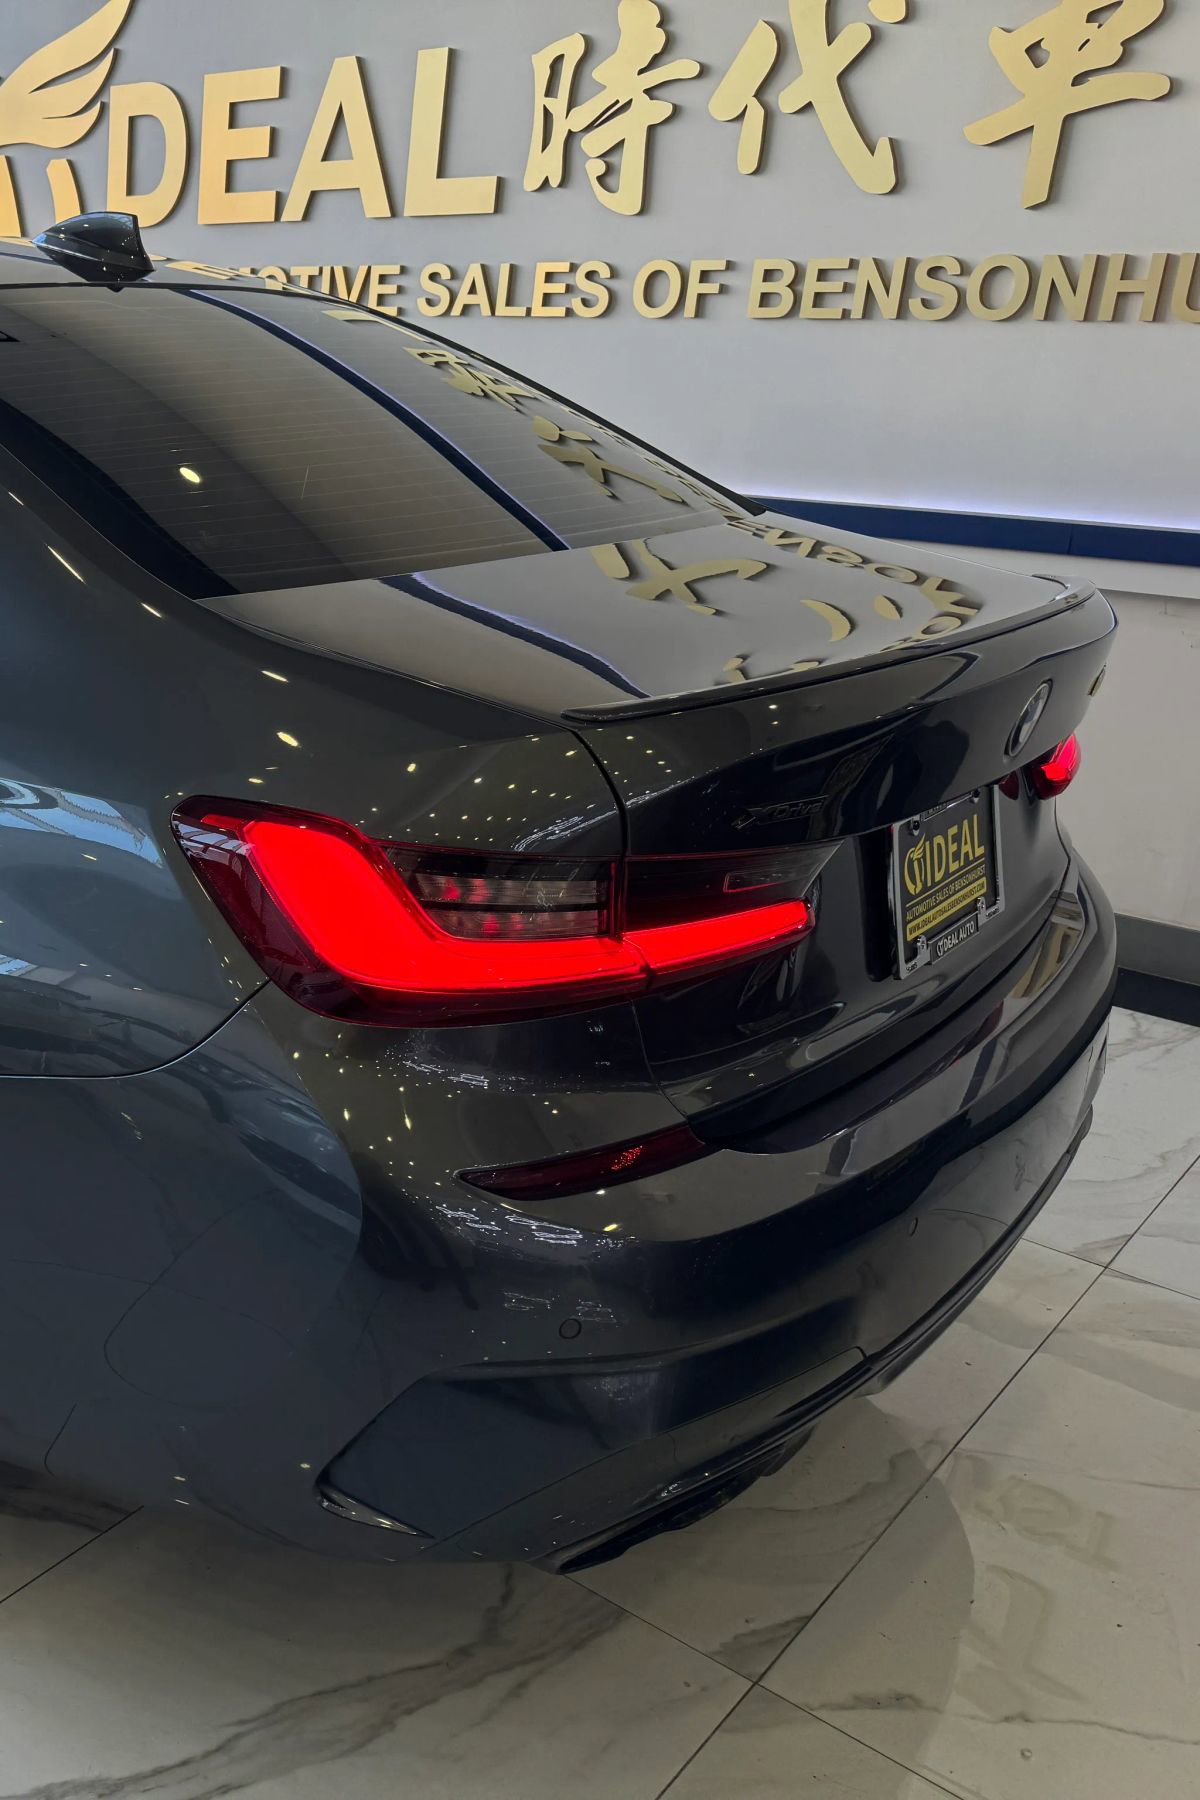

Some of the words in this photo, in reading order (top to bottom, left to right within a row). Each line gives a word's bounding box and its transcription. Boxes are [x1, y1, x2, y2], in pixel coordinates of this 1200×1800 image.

[240, 264, 401, 317] TIVE
[416, 260, 612, 318] SALES
[632, 259, 727, 319] OF
[926, 813, 985, 887] IDEAL
[958, 919, 975, 942] AUTO
